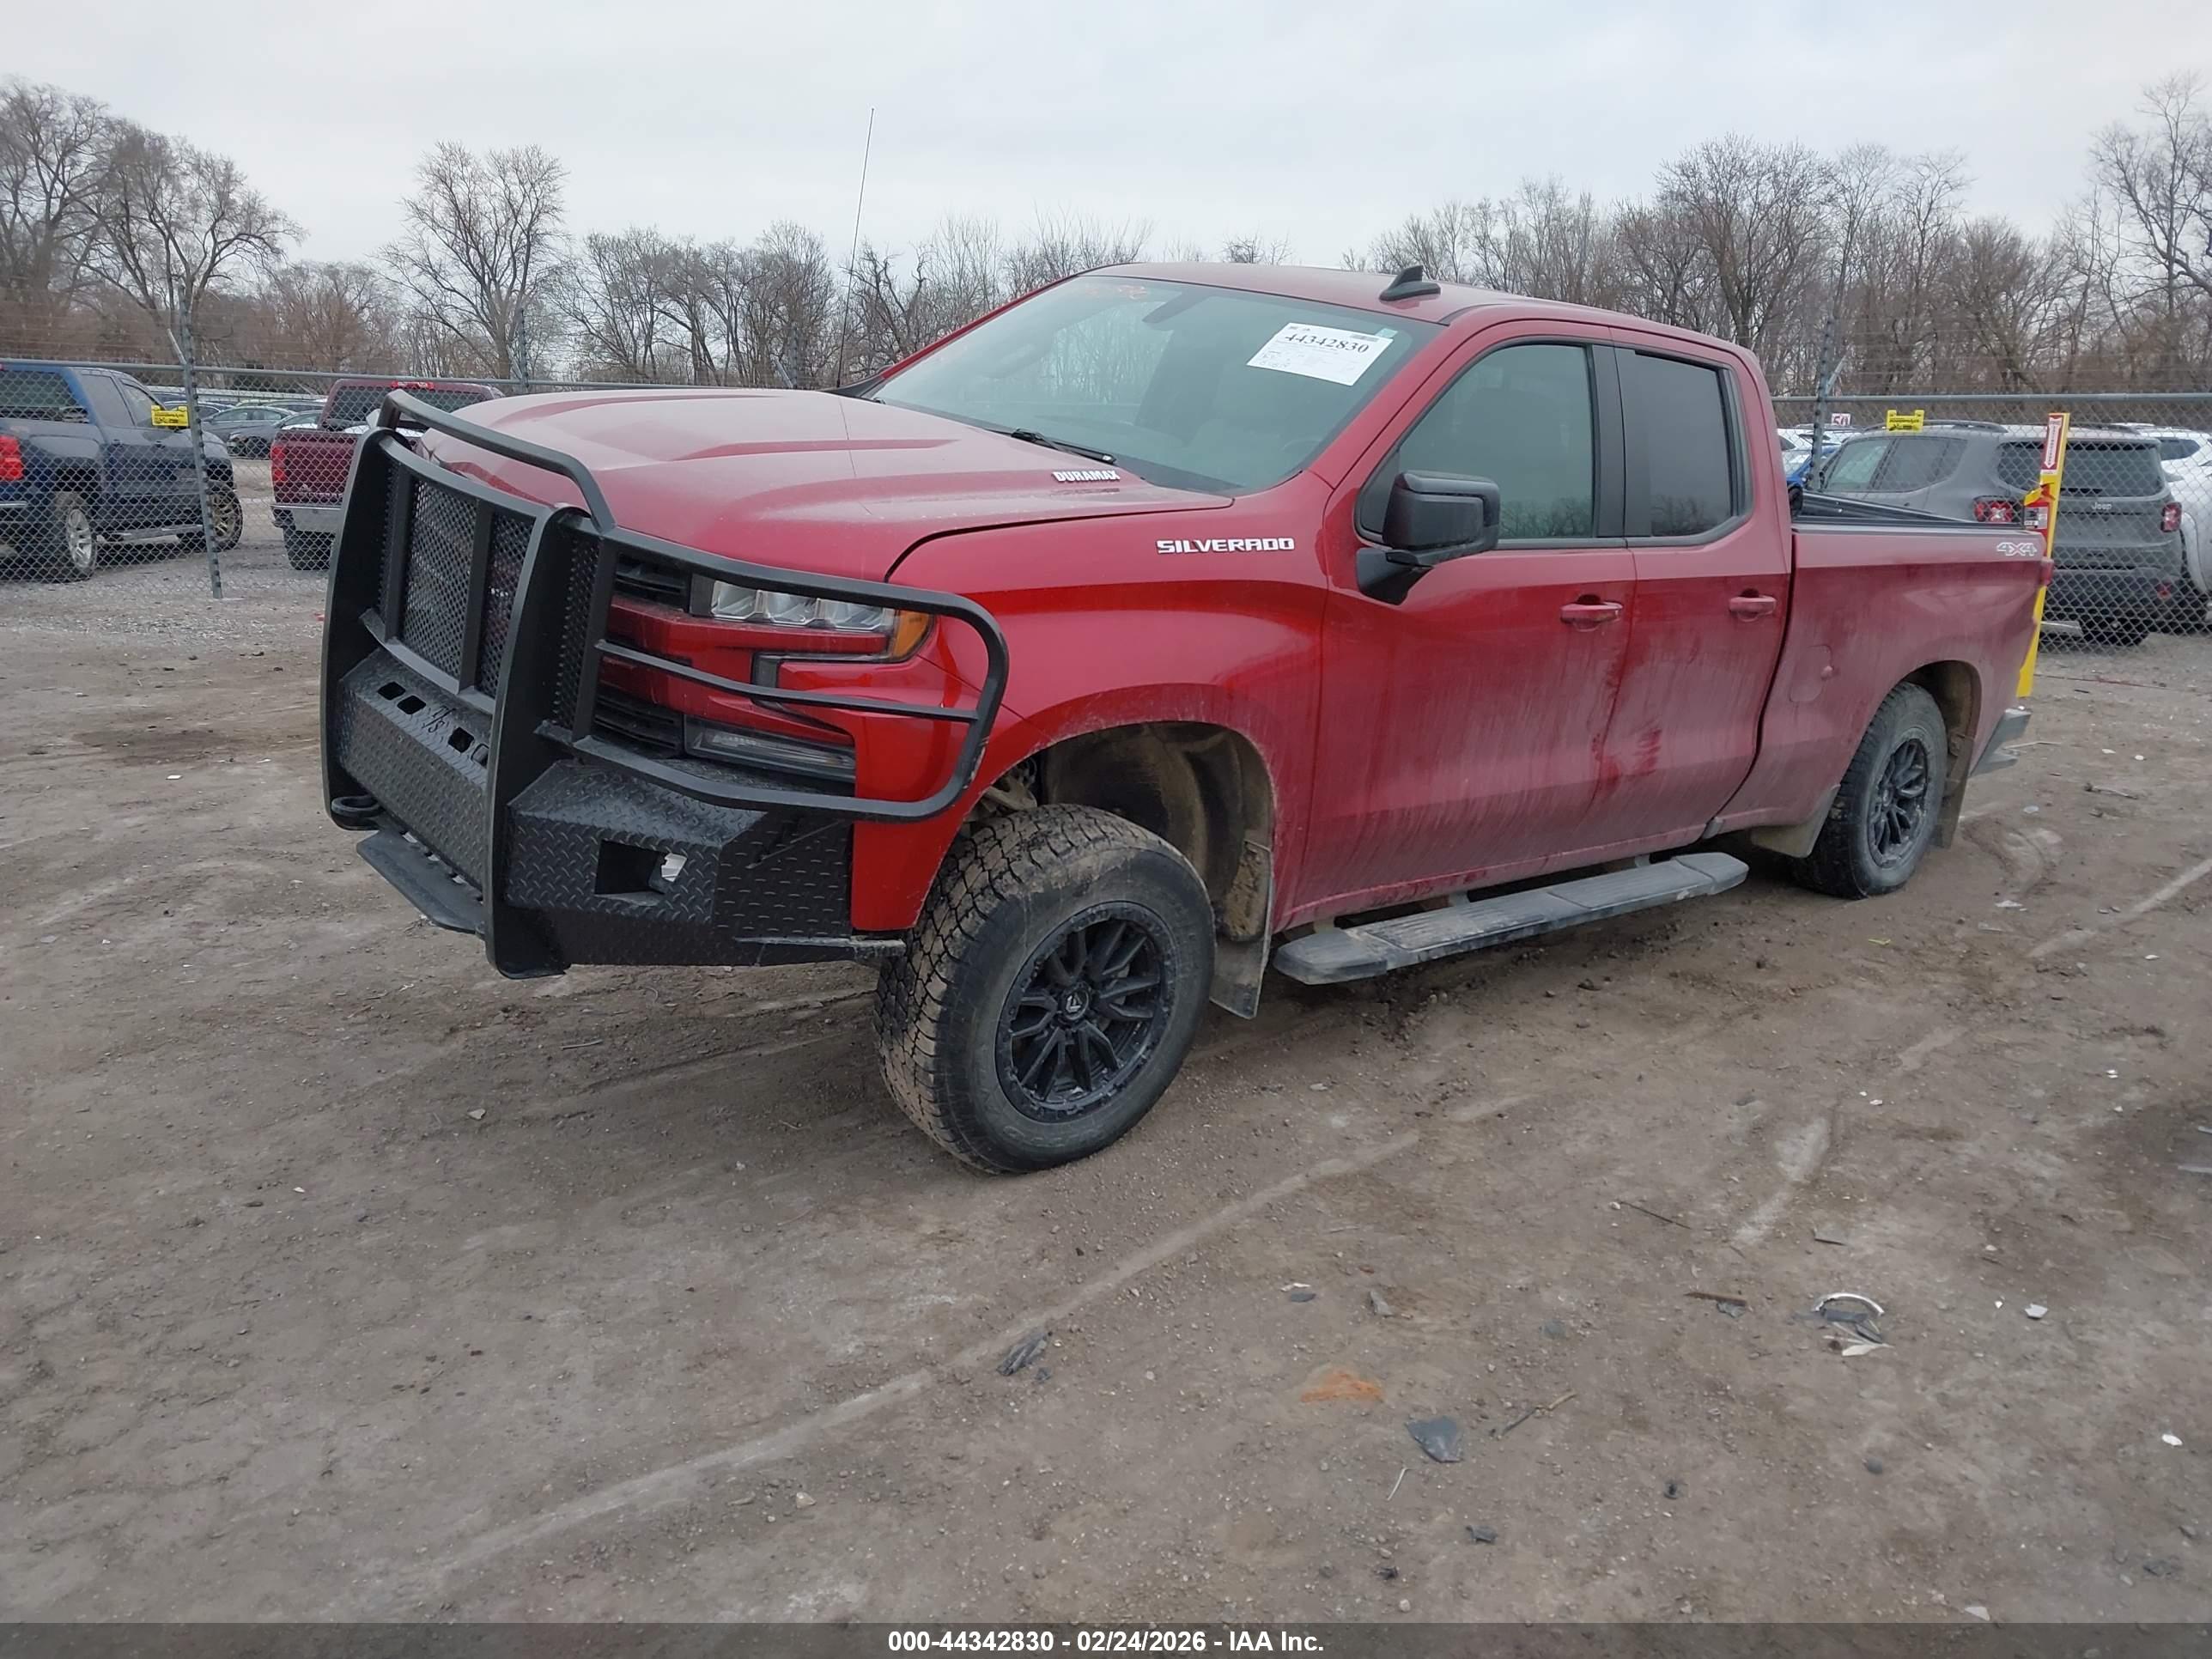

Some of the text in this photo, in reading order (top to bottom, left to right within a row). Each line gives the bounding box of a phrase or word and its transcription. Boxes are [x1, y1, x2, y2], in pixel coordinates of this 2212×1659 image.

[1285, 333, 1370, 353] 44342830
[1052, 470, 1121, 483] DURAMAX
[2091, 501, 2112, 510] Jeep
[1156, 538, 1295, 554] SILVERADO
